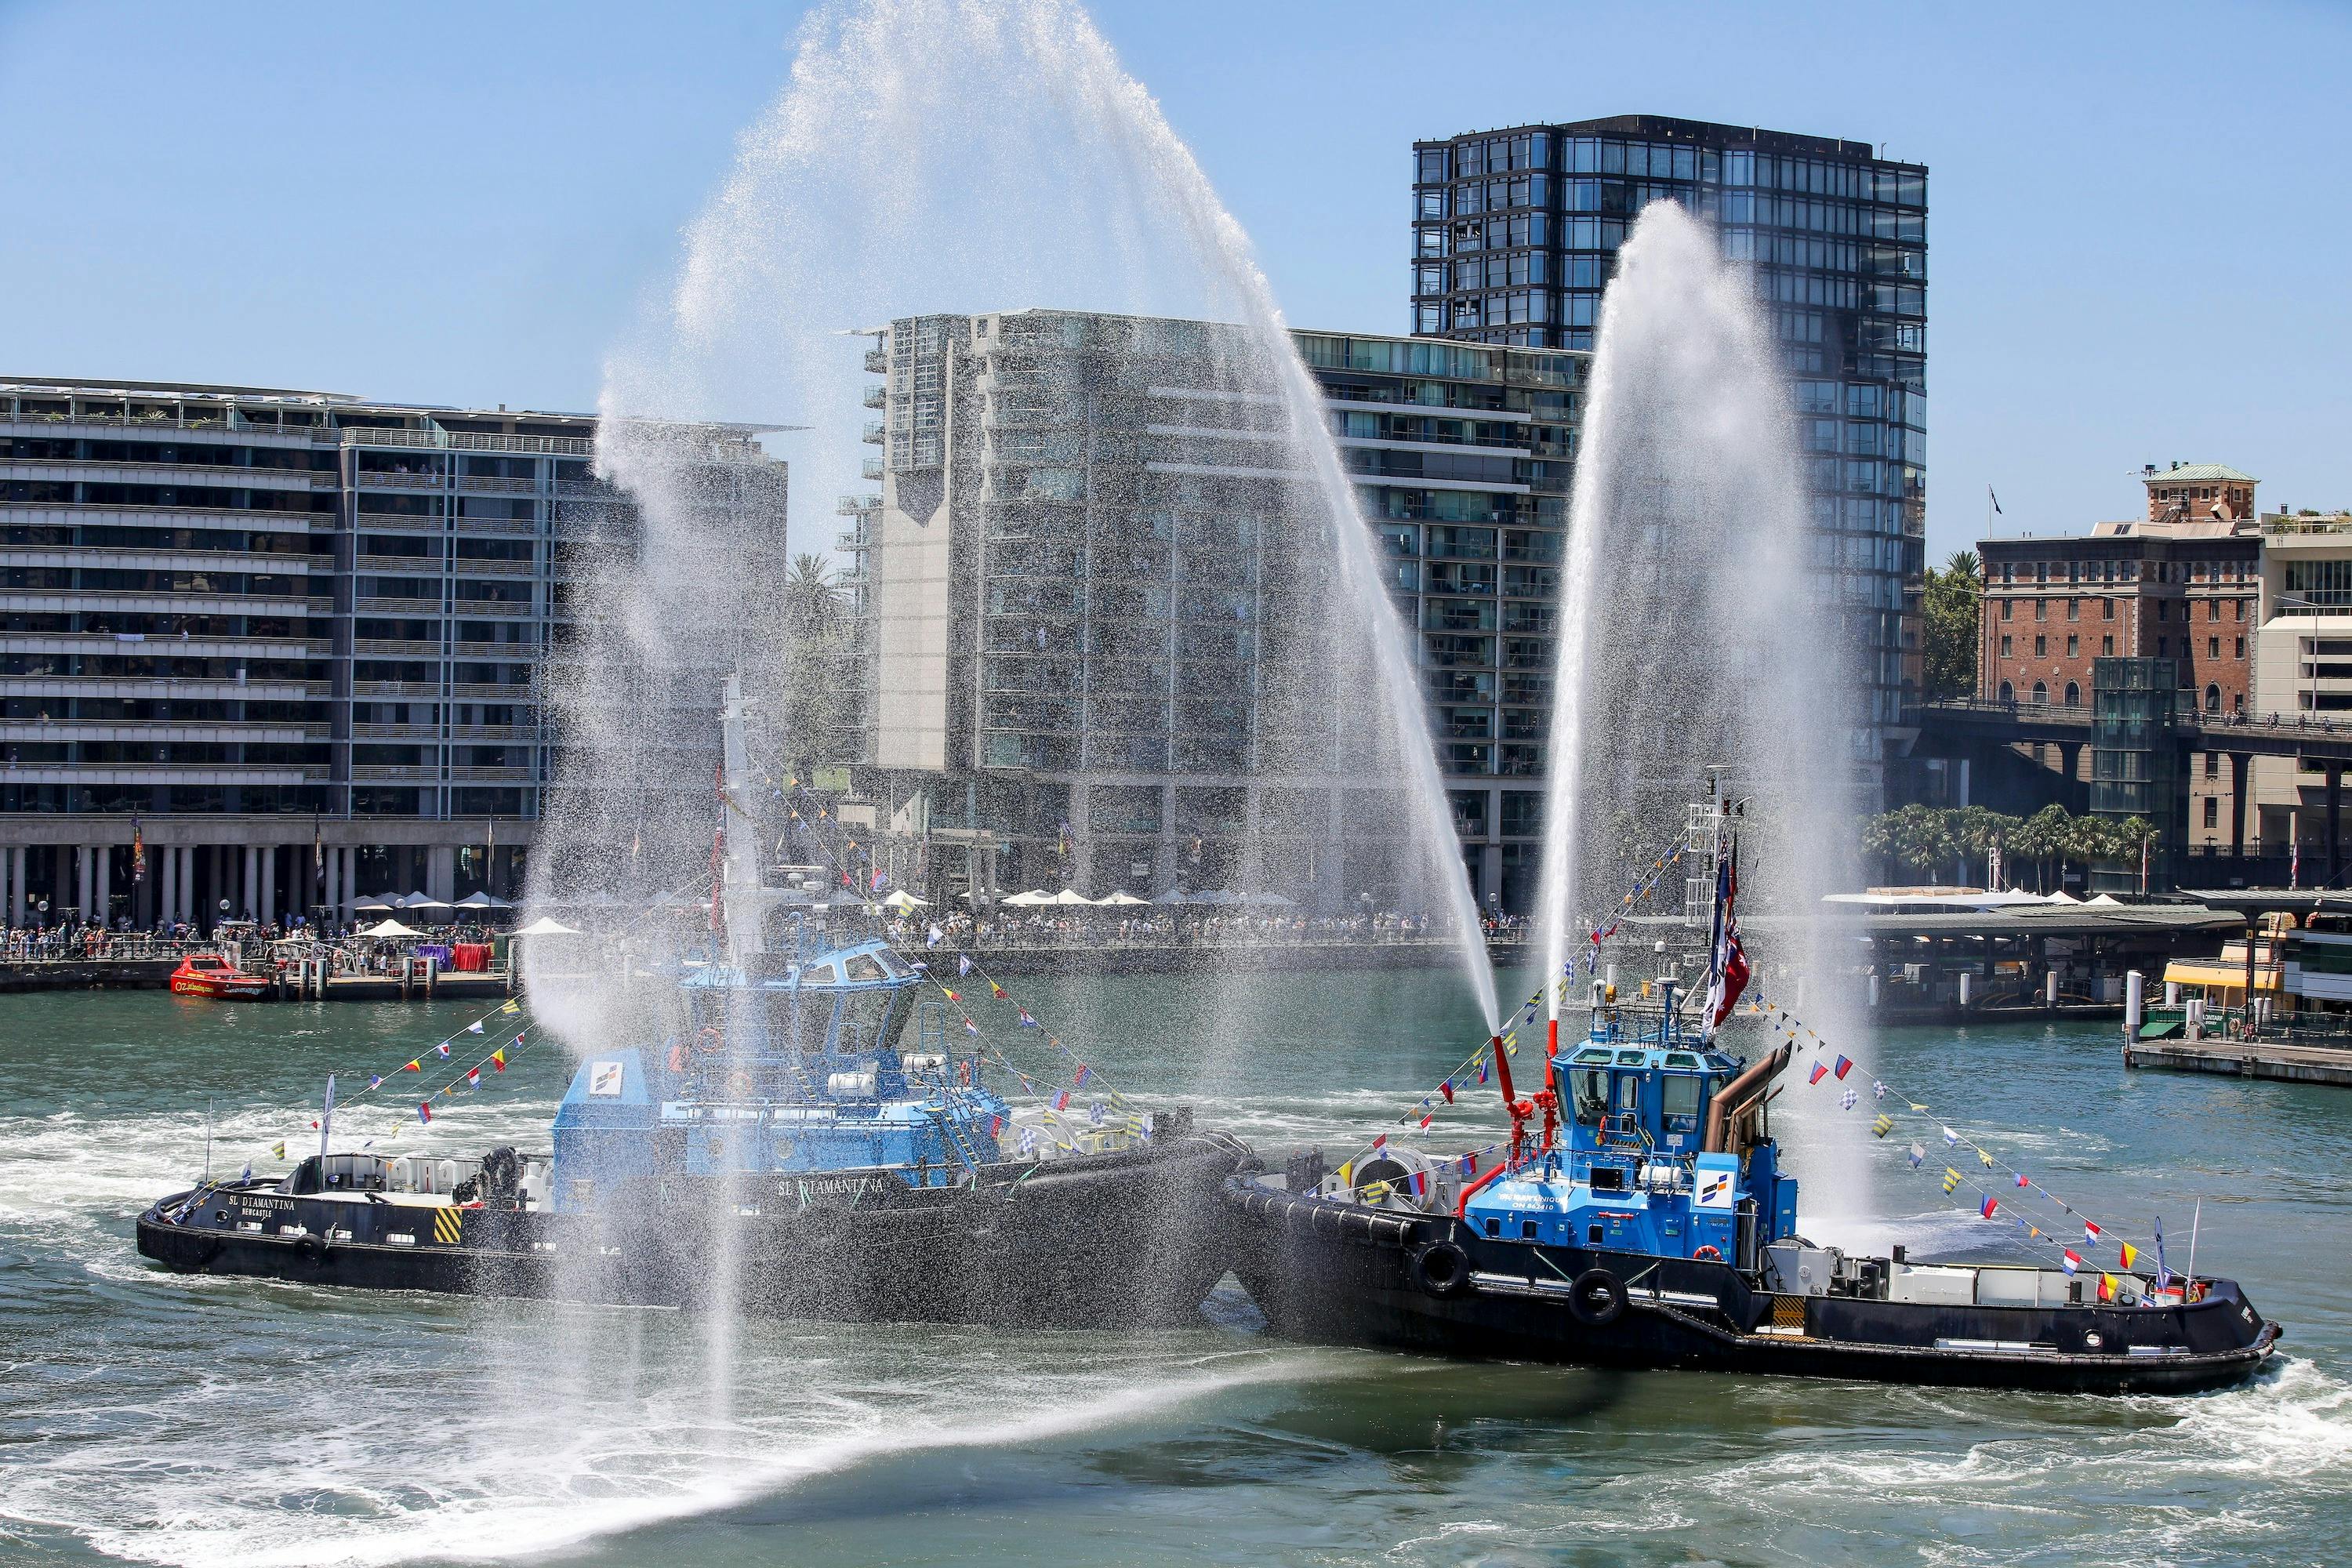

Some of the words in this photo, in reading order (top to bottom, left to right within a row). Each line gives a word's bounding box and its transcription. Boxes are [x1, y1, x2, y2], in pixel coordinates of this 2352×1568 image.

[778, 1181, 793, 1196] SL
[229, 1196, 238, 1206] SL
[242, 1197, 295, 1210] DIAMANTINA
[241, 1208, 272, 1218] NEWCASTLE
